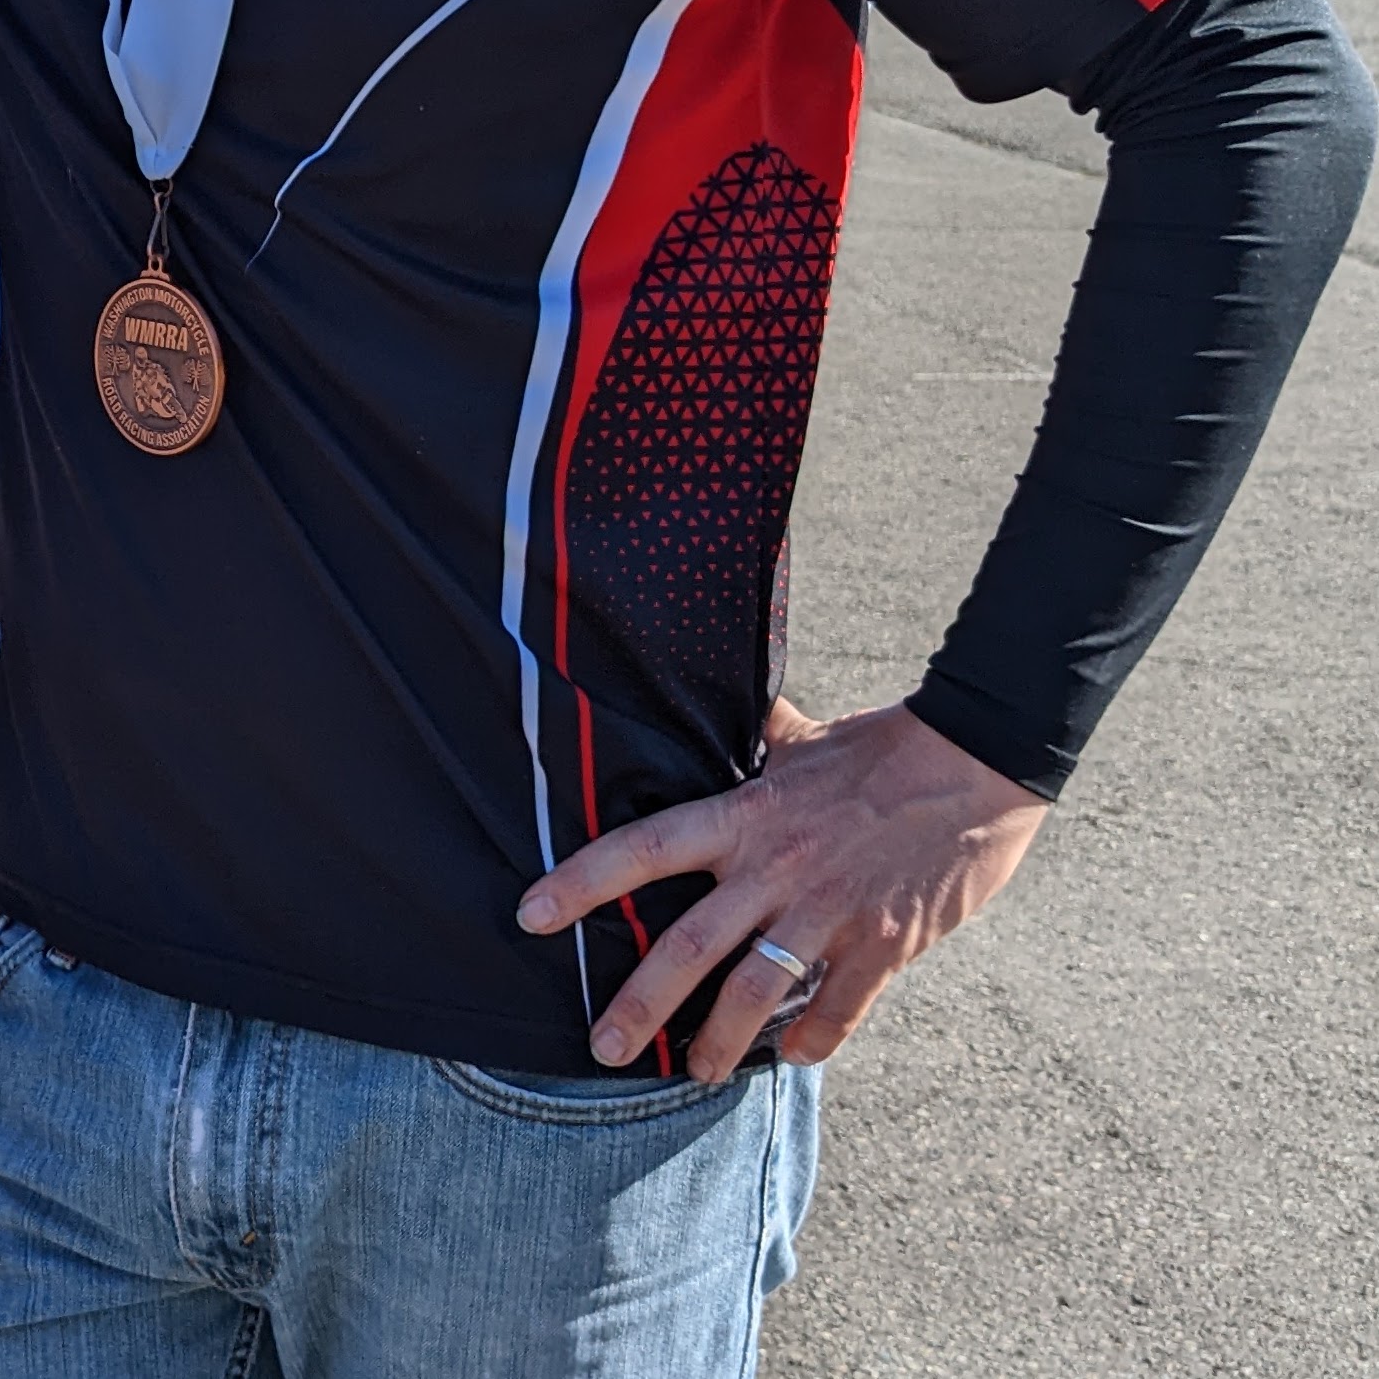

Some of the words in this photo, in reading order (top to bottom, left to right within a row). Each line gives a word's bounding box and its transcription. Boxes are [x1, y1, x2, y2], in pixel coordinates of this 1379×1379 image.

[102, 287, 153, 340] WASHINGTON
[154, 288, 210, 356] MOTORCYCLE
[125, 317, 188, 352] WMRRA
[102, 377, 121, 414] ROAD
[120, 411, 156, 445] RACING
[156, 395, 210, 447] ASSOCIATION
